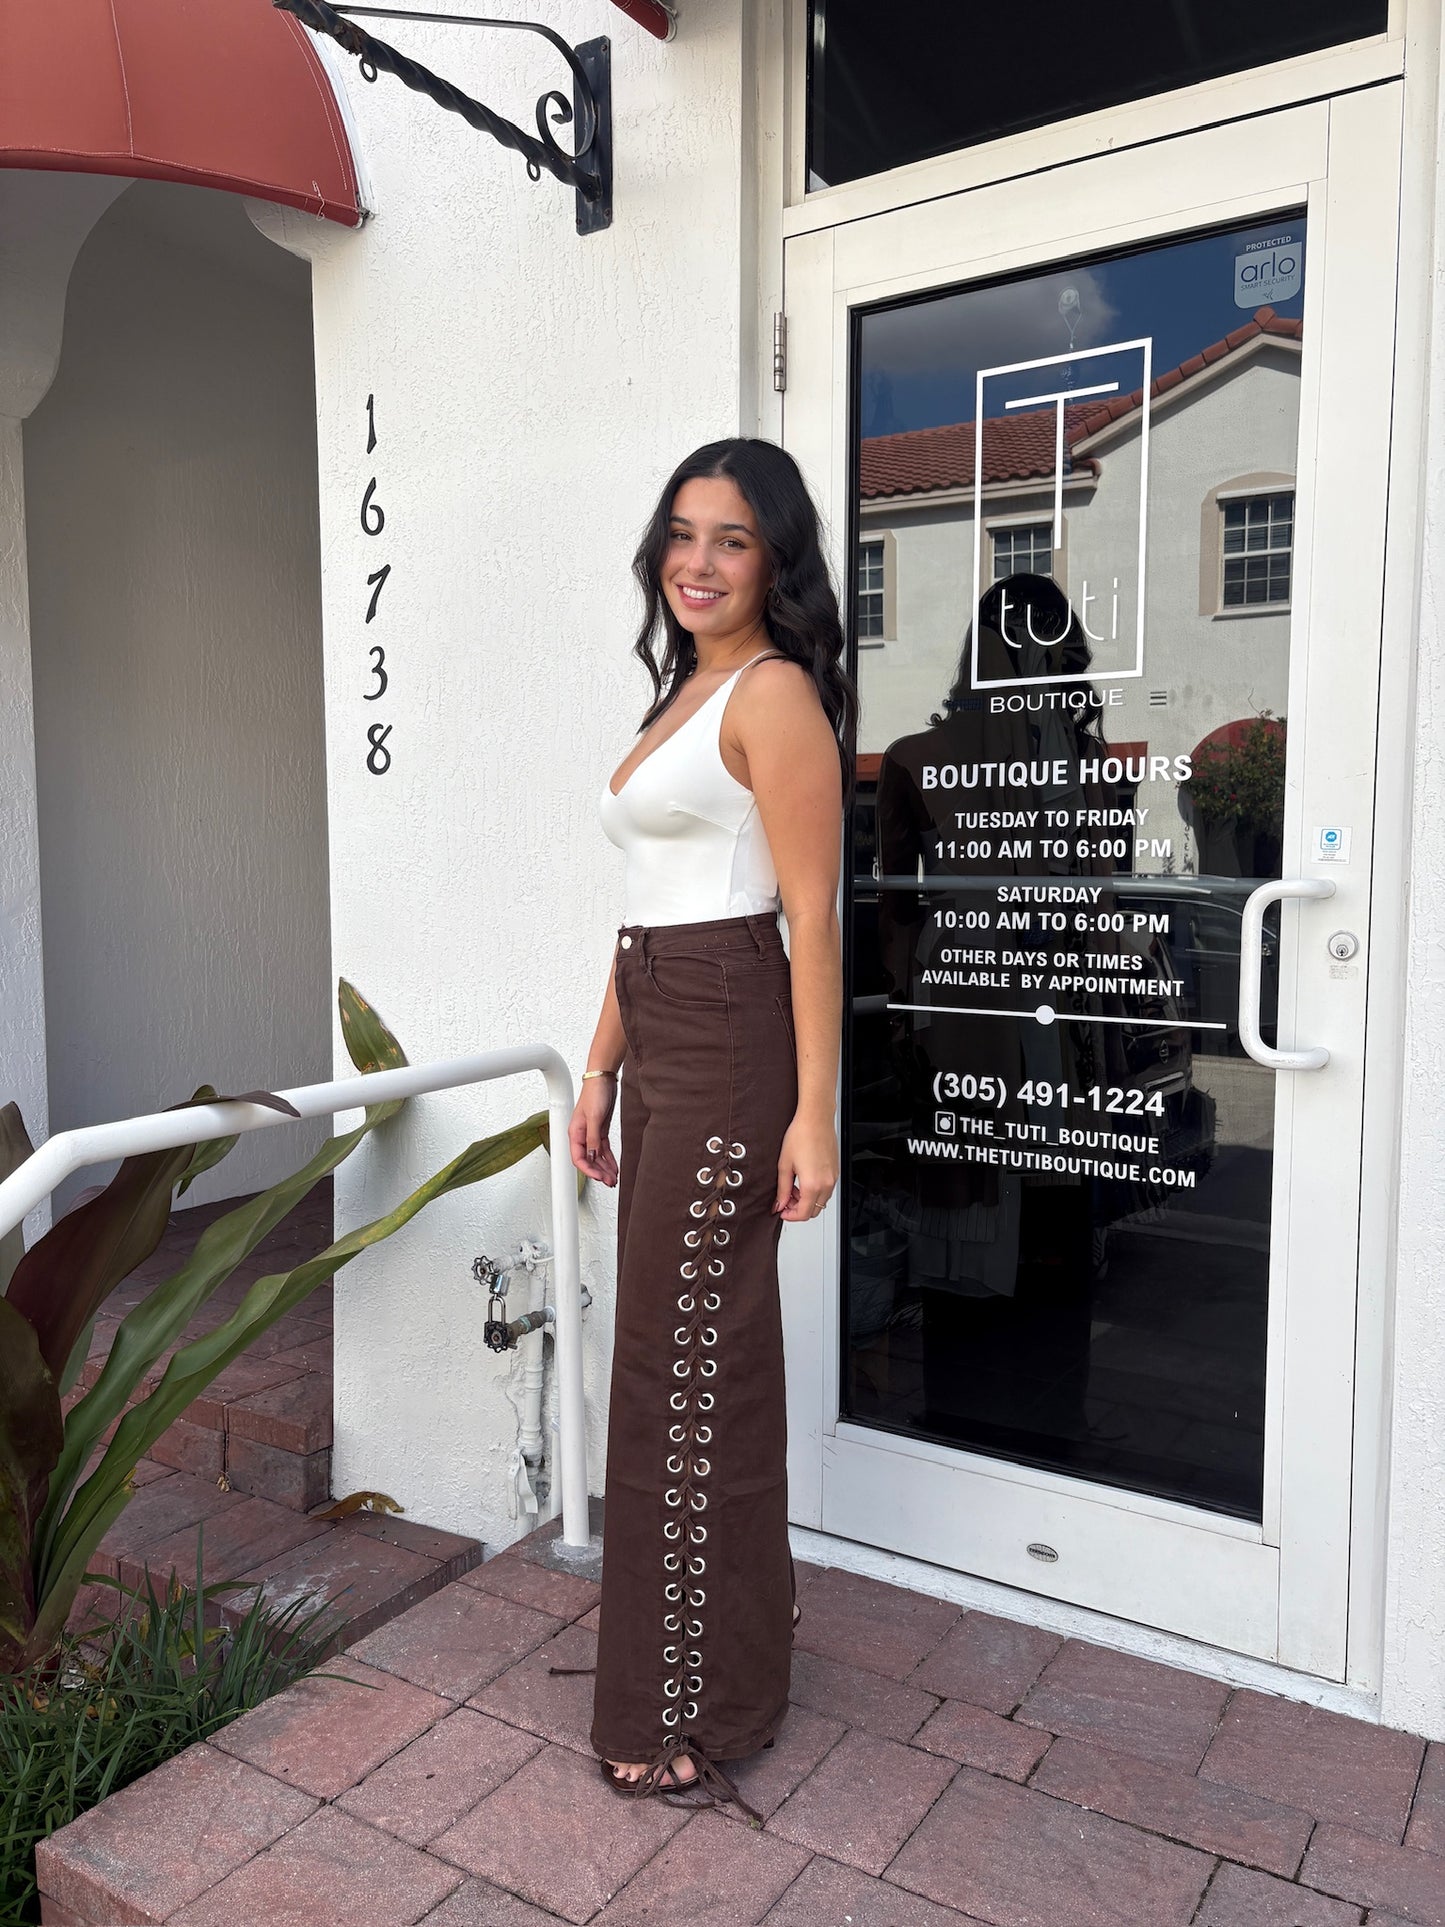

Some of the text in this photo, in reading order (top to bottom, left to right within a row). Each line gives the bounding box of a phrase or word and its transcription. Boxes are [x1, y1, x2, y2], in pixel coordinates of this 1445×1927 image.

[1246, 235, 1292, 252] PROTECTED
[1241, 251, 1296, 283] arlo
[1005, 382, 1119, 550] T
[360, 393, 393, 775] 16738
[1001, 577, 1118, 648] tuti
[990, 688, 1124, 714] BOUTIQUE
[922, 754, 1193, 790] BOUTIQUE HOURS
[955, 808, 1150, 829] TUESDAY TO FRIDAY
[934, 838, 1171, 859] 11:00 AM TO 6:00 PM
[997, 886, 1102, 904] SATURDAY
[933, 911, 1170, 934] 10:00 AM TO 6:00 PM
[940, 948, 1143, 971] OTHER DAYS OR TIMES
[921, 970, 1184, 997] AVAILABLE BY APPOINTMENT
[933, 1071, 1165, 1117] (305) 491-1224
[960, 1116, 1160, 1155] THE_TUTI_BOUTIQUE
[907, 1137, 1197, 1188] WWW.THETUTIBOUTIQUE.COM
